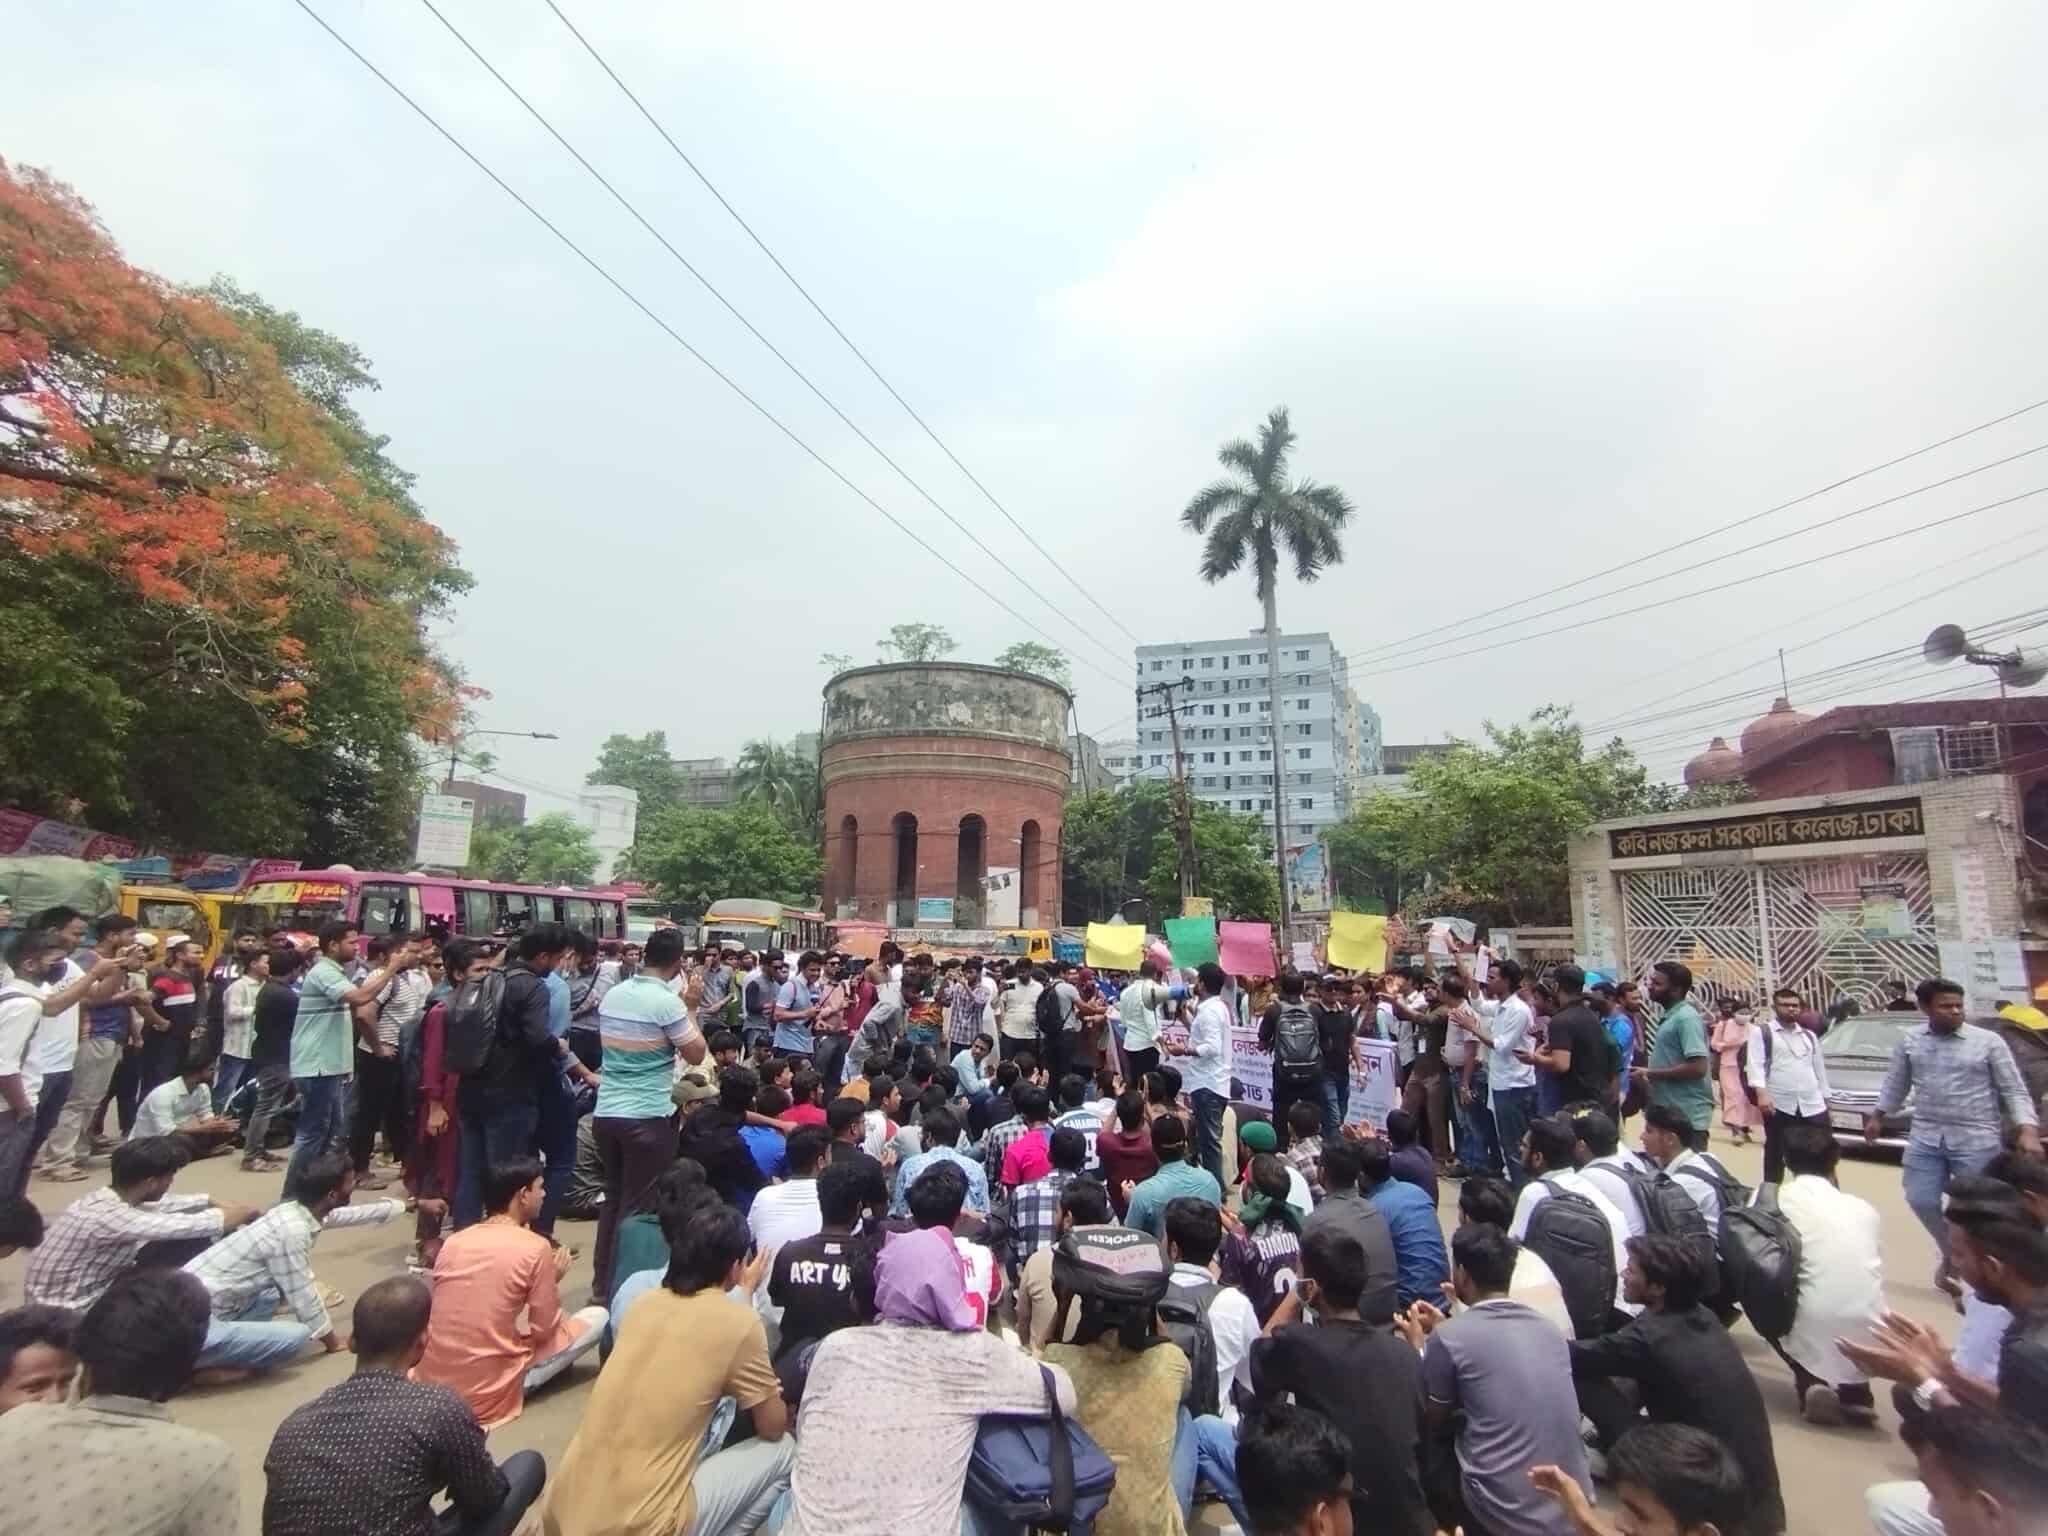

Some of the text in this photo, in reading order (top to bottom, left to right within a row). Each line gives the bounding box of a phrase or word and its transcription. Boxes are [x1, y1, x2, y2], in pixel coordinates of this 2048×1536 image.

[1616, 831, 1647, 855] কবি
[1649, 828, 1712, 853] নজরুল
[1715, 816, 1788, 847] সরকারি
[1864, 807, 1919, 835] ঢাকা
[1256, 1231, 1300, 1261] RIMON
[790, 1261, 829, 1285] ART
